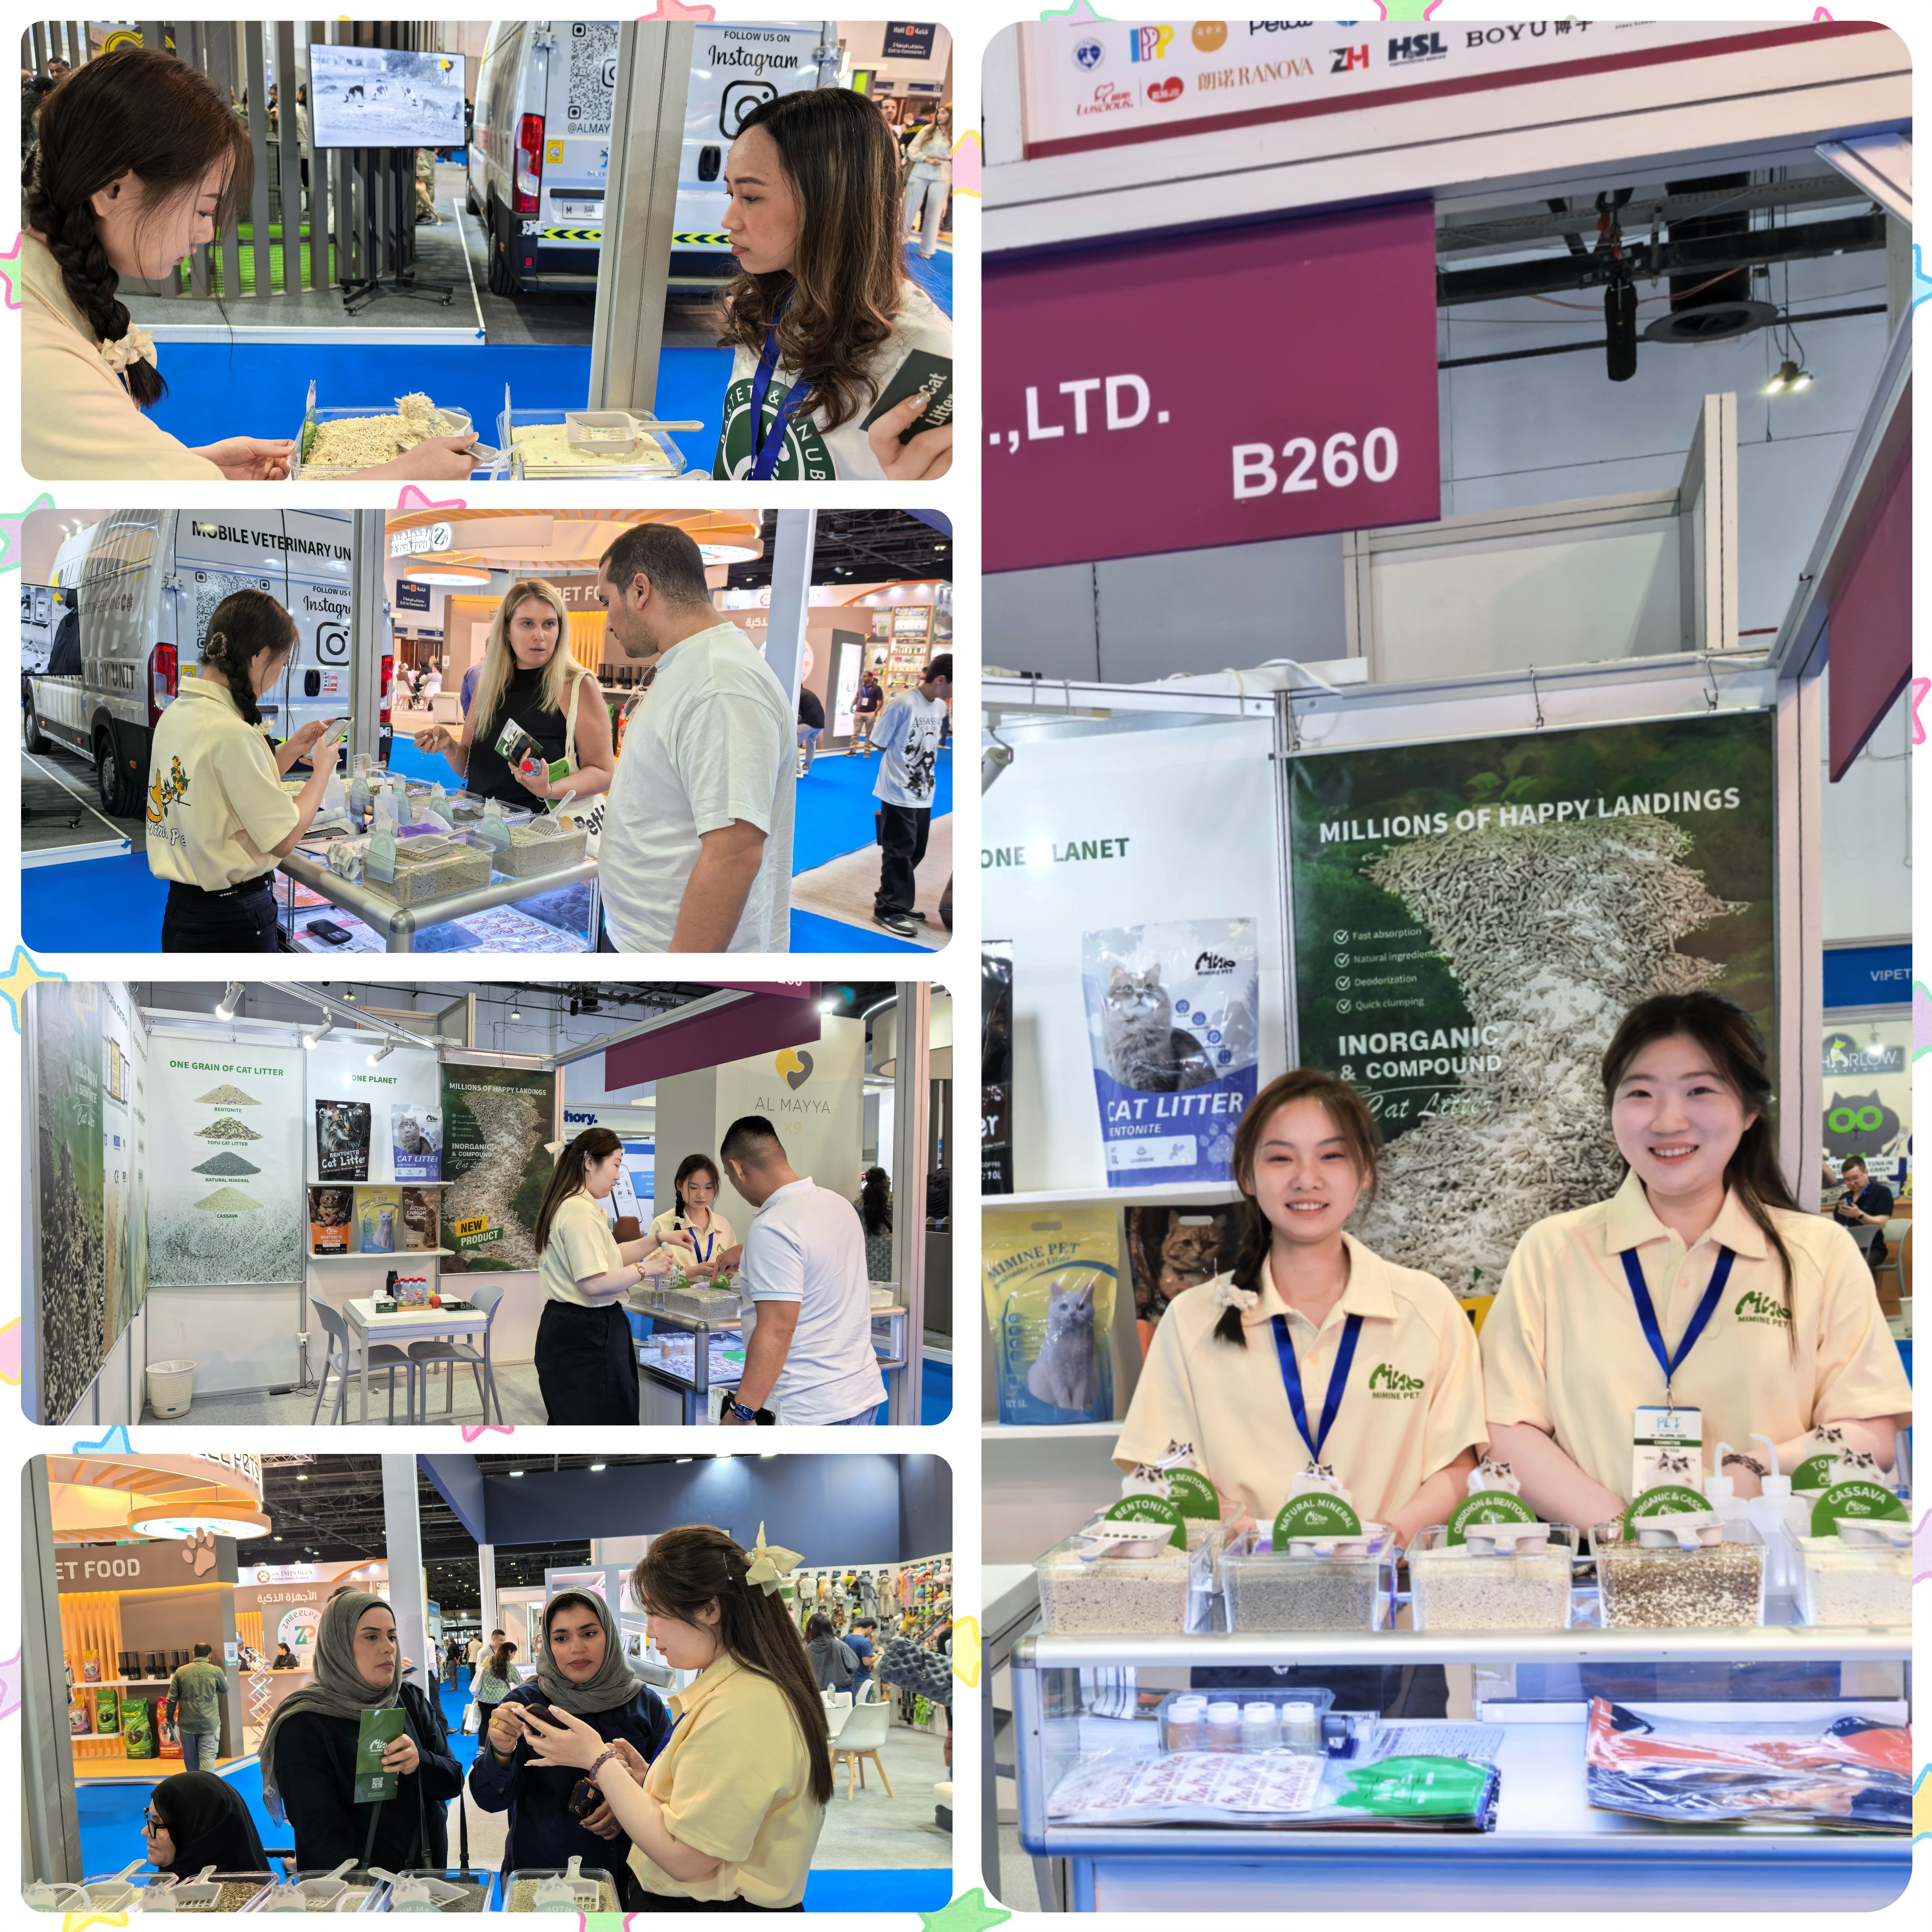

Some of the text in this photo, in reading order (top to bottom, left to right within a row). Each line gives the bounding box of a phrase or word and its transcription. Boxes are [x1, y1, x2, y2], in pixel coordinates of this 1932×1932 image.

[724, 31, 790, 43] FOLLOW US ON
[1466, 21, 1548, 48] BOYU
[1388, 32, 1448, 62] HSL
[708, 45, 798, 76] Instagram
[1329, 44, 1369, 73] ZH
[1239, 57, 1314, 85] RANOVA
[768, 390, 779, 405] &
[1232, 427, 1399, 500] B260
[192, 521, 249, 544] MOBILE
[251, 531, 331, 558] VETERINARY
[313, 586, 338, 595] FOLLOW
[112, 664, 135, 690] UNIT
[1320, 788, 1741, 844] MILLIONS OF HAPPY LANDINGS
[1353, 928, 1422, 941] Fast absorption
[1354, 950, 1438, 963] Natural ingredients
[1355, 975, 1417, 987] Deodorization
[1870, 968, 1911, 982] VIPET
[1355, 997, 1424, 1011] Quick clumping
[1339, 1025, 1500, 1056] INORGANIC
[170, 1060, 189, 1069] ONE
[192, 1062, 220, 1071] GRAIN
[254, 1067, 284, 1076] LITTER
[1340, 1055, 1502, 1080] & COMPOUND
[369, 1076, 397, 1084] PLANET
[450, 1083, 481, 1091] MILLIONS
[516, 1087, 546, 1096] LANDINGS
[756, 1096, 831, 1115] AL MAYYA
[1107, 1092, 1243, 1122] CAT LITTER
[1369, 1092, 1493, 1121] Cat Litter
[785, 1120, 802, 1135] K9
[322, 1155, 365, 1168] Cat Litter
[456, 1160, 468, 1169] Cat
[359, 1199, 377, 1208] MIMINE
[461, 1219, 482, 1233] NEW
[461, 1230, 498, 1246] PRODUCT
[987, 1241, 1080, 1281] MIMINE PET
[1738, 1316, 1788, 1329] MIMINE PET
[1373, 1391, 1401, 1400] MIMINE
[1176, 1474, 1213, 1503] BENTONITE
[1671, 1492, 1679, 1501] &
[1828, 1486, 1887, 1505] CASSAVA
[1114, 1499, 1173, 1521] BENTONITE
[1279, 1499, 1355, 1532] NATURAL MINERAL
[1453, 1497, 1493, 1534] OBSIDION &
[85, 1558, 141, 1579] FOOD
[257, 1589, 317, 1605] الأجهزة الذكية
